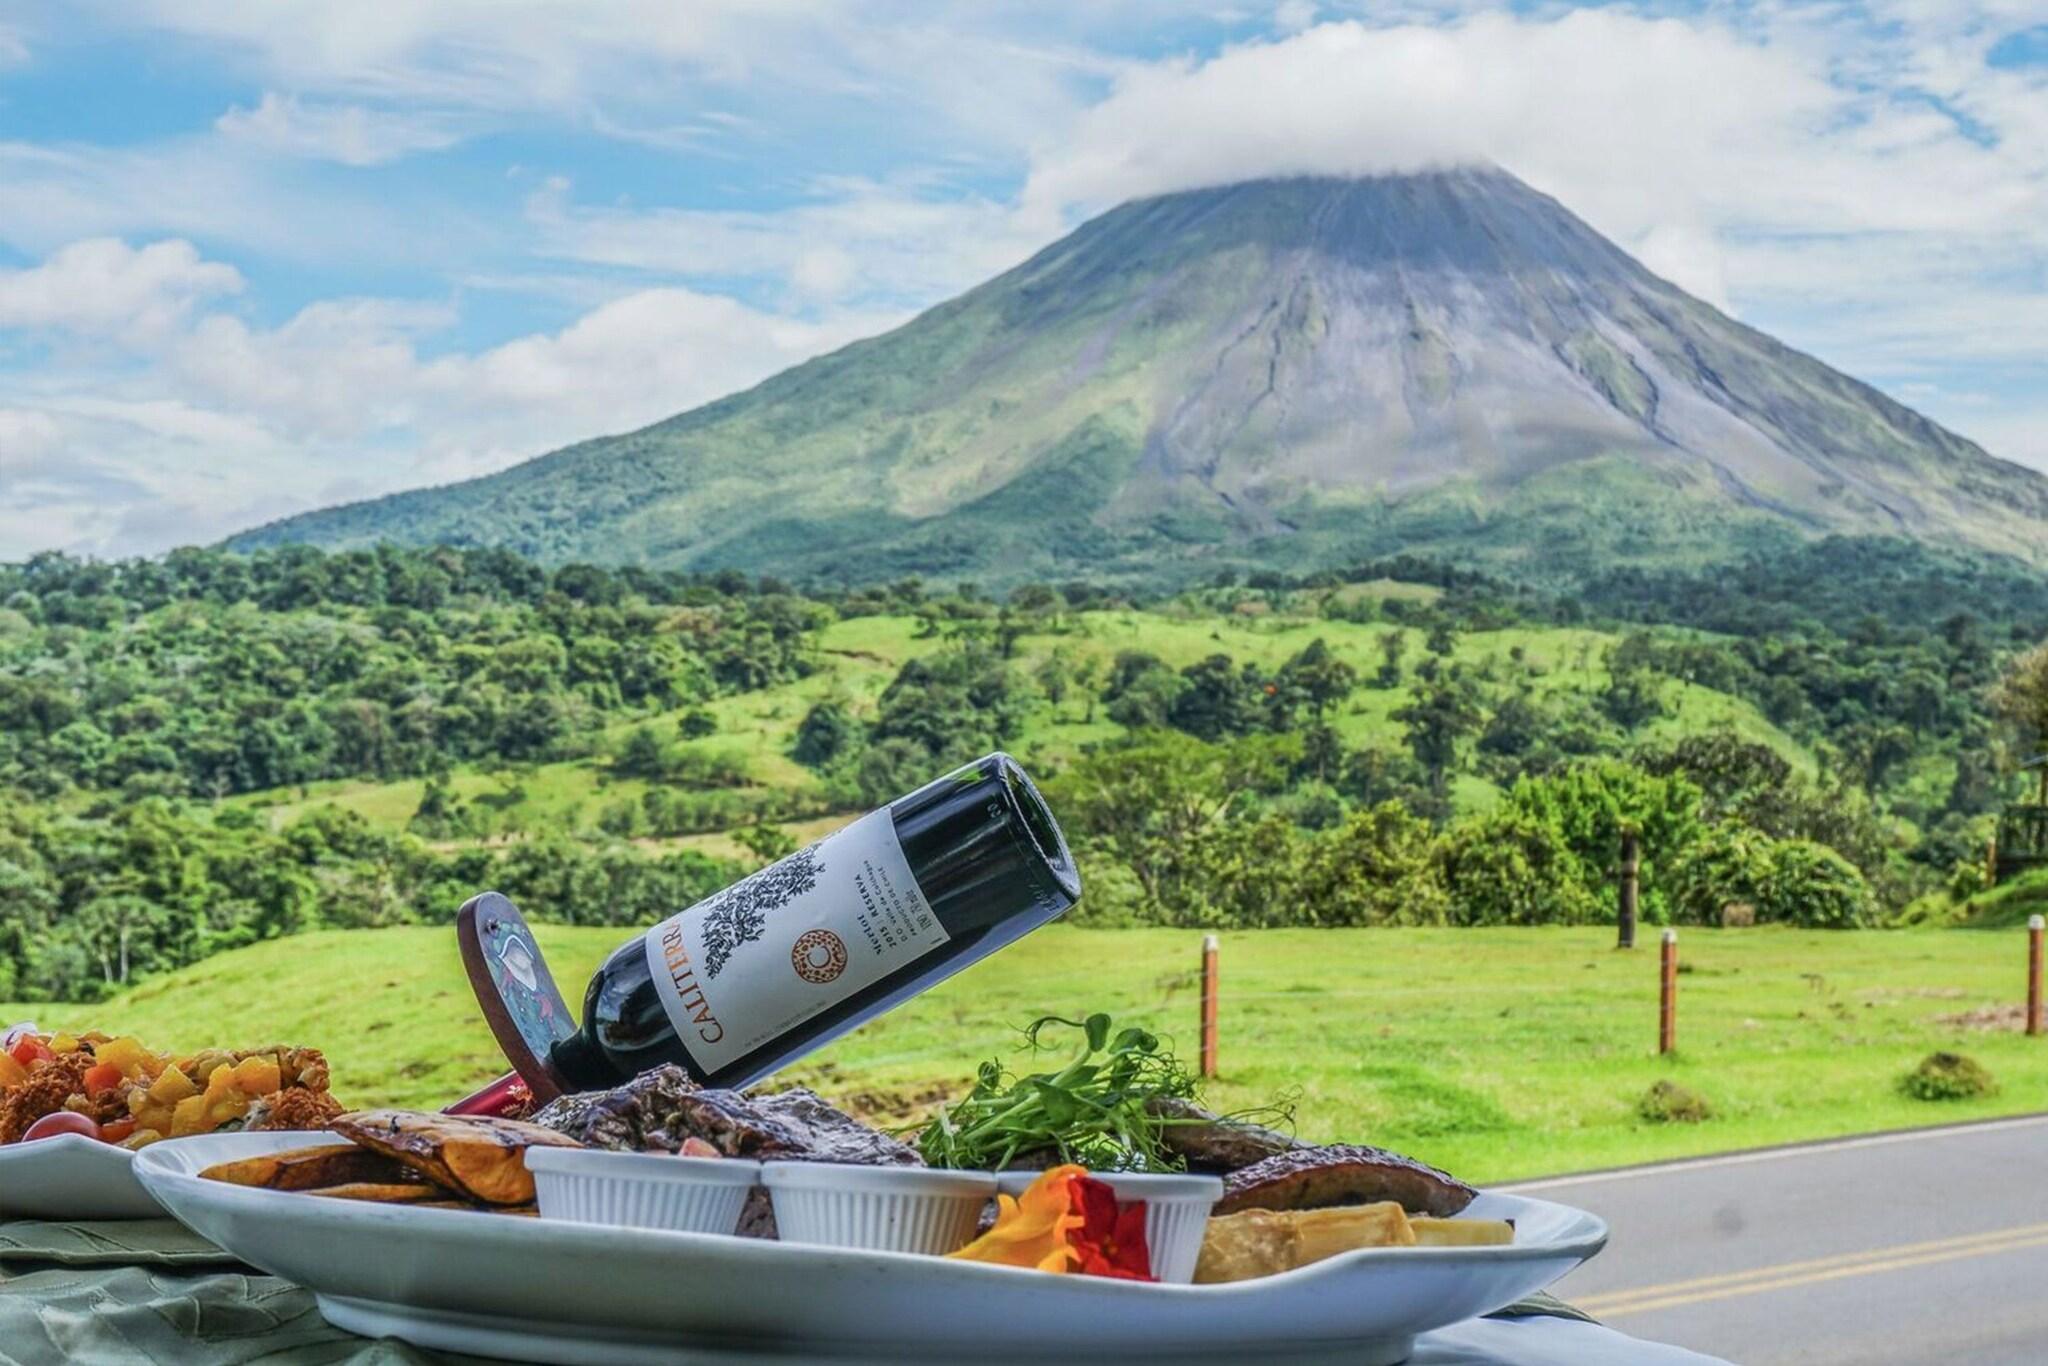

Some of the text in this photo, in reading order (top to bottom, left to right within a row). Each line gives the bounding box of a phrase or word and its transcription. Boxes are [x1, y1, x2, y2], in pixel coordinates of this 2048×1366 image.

[854, 874, 897, 948] 2015 RESERVA
[857, 914, 883, 955] Merlot
